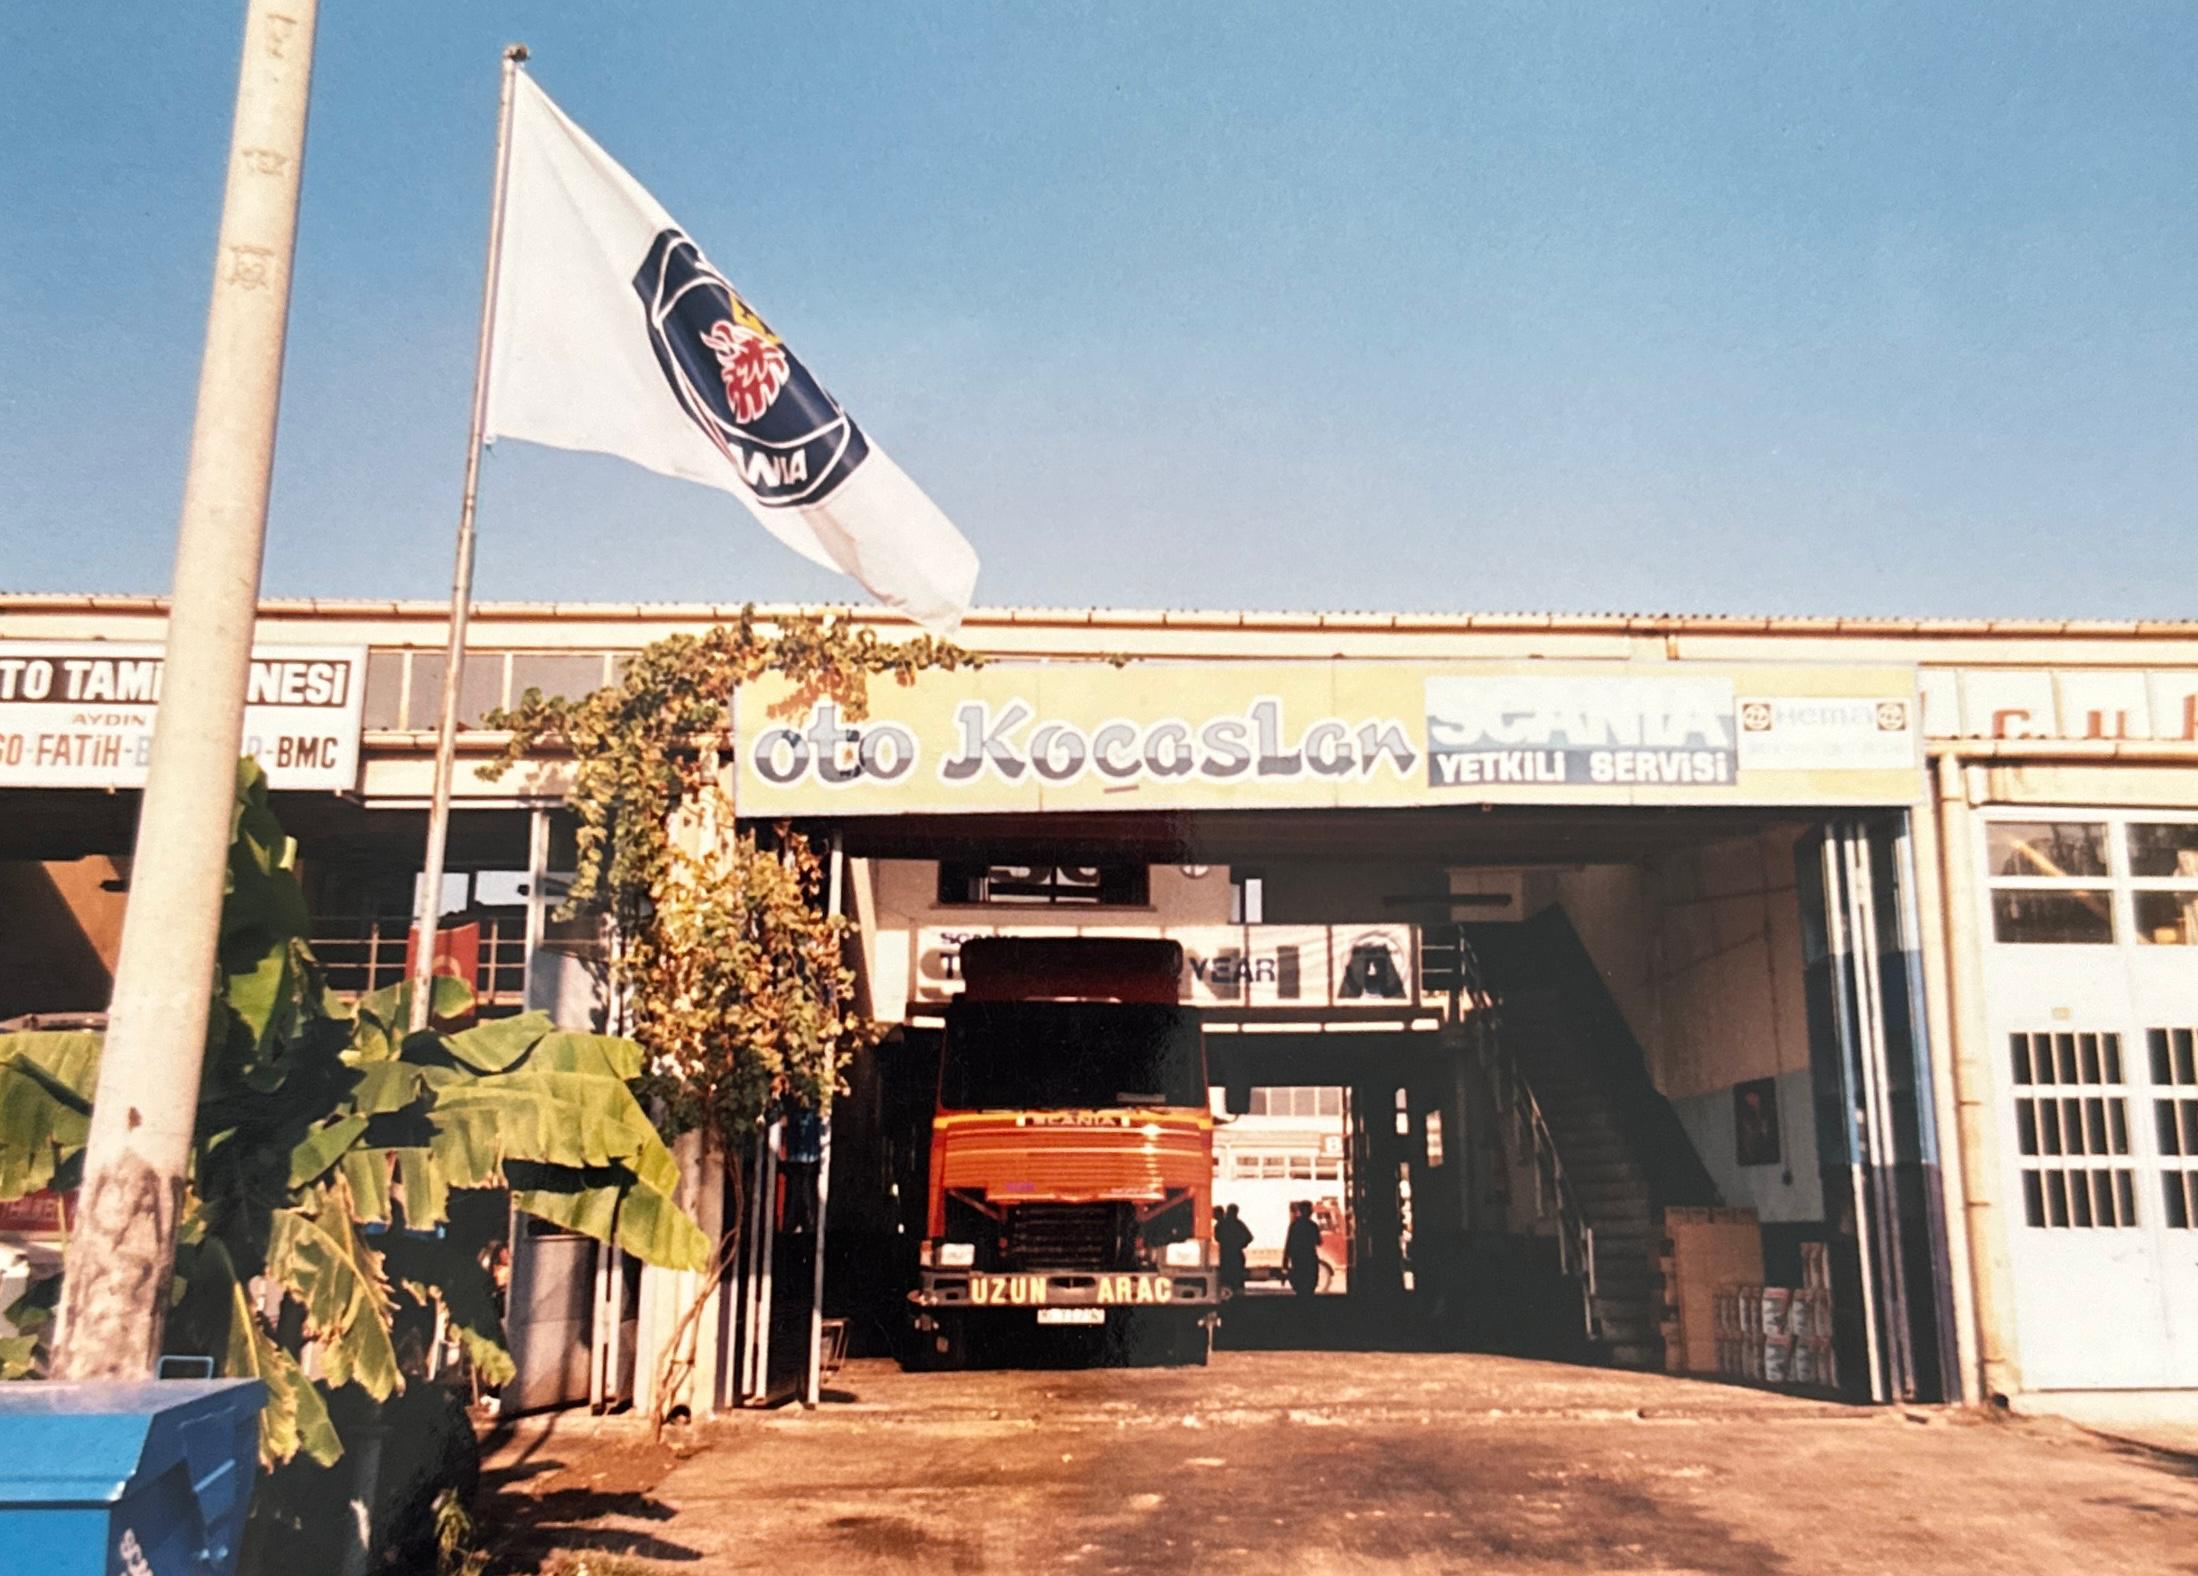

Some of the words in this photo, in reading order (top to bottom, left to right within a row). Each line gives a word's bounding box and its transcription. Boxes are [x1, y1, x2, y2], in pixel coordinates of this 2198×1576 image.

[72, 713, 146, 726] AYDIN
[753, 703, 914, 784] oto
[1189, 957, 1276, 984] YEAR
[971, 1277, 1047, 1304] UZUN
